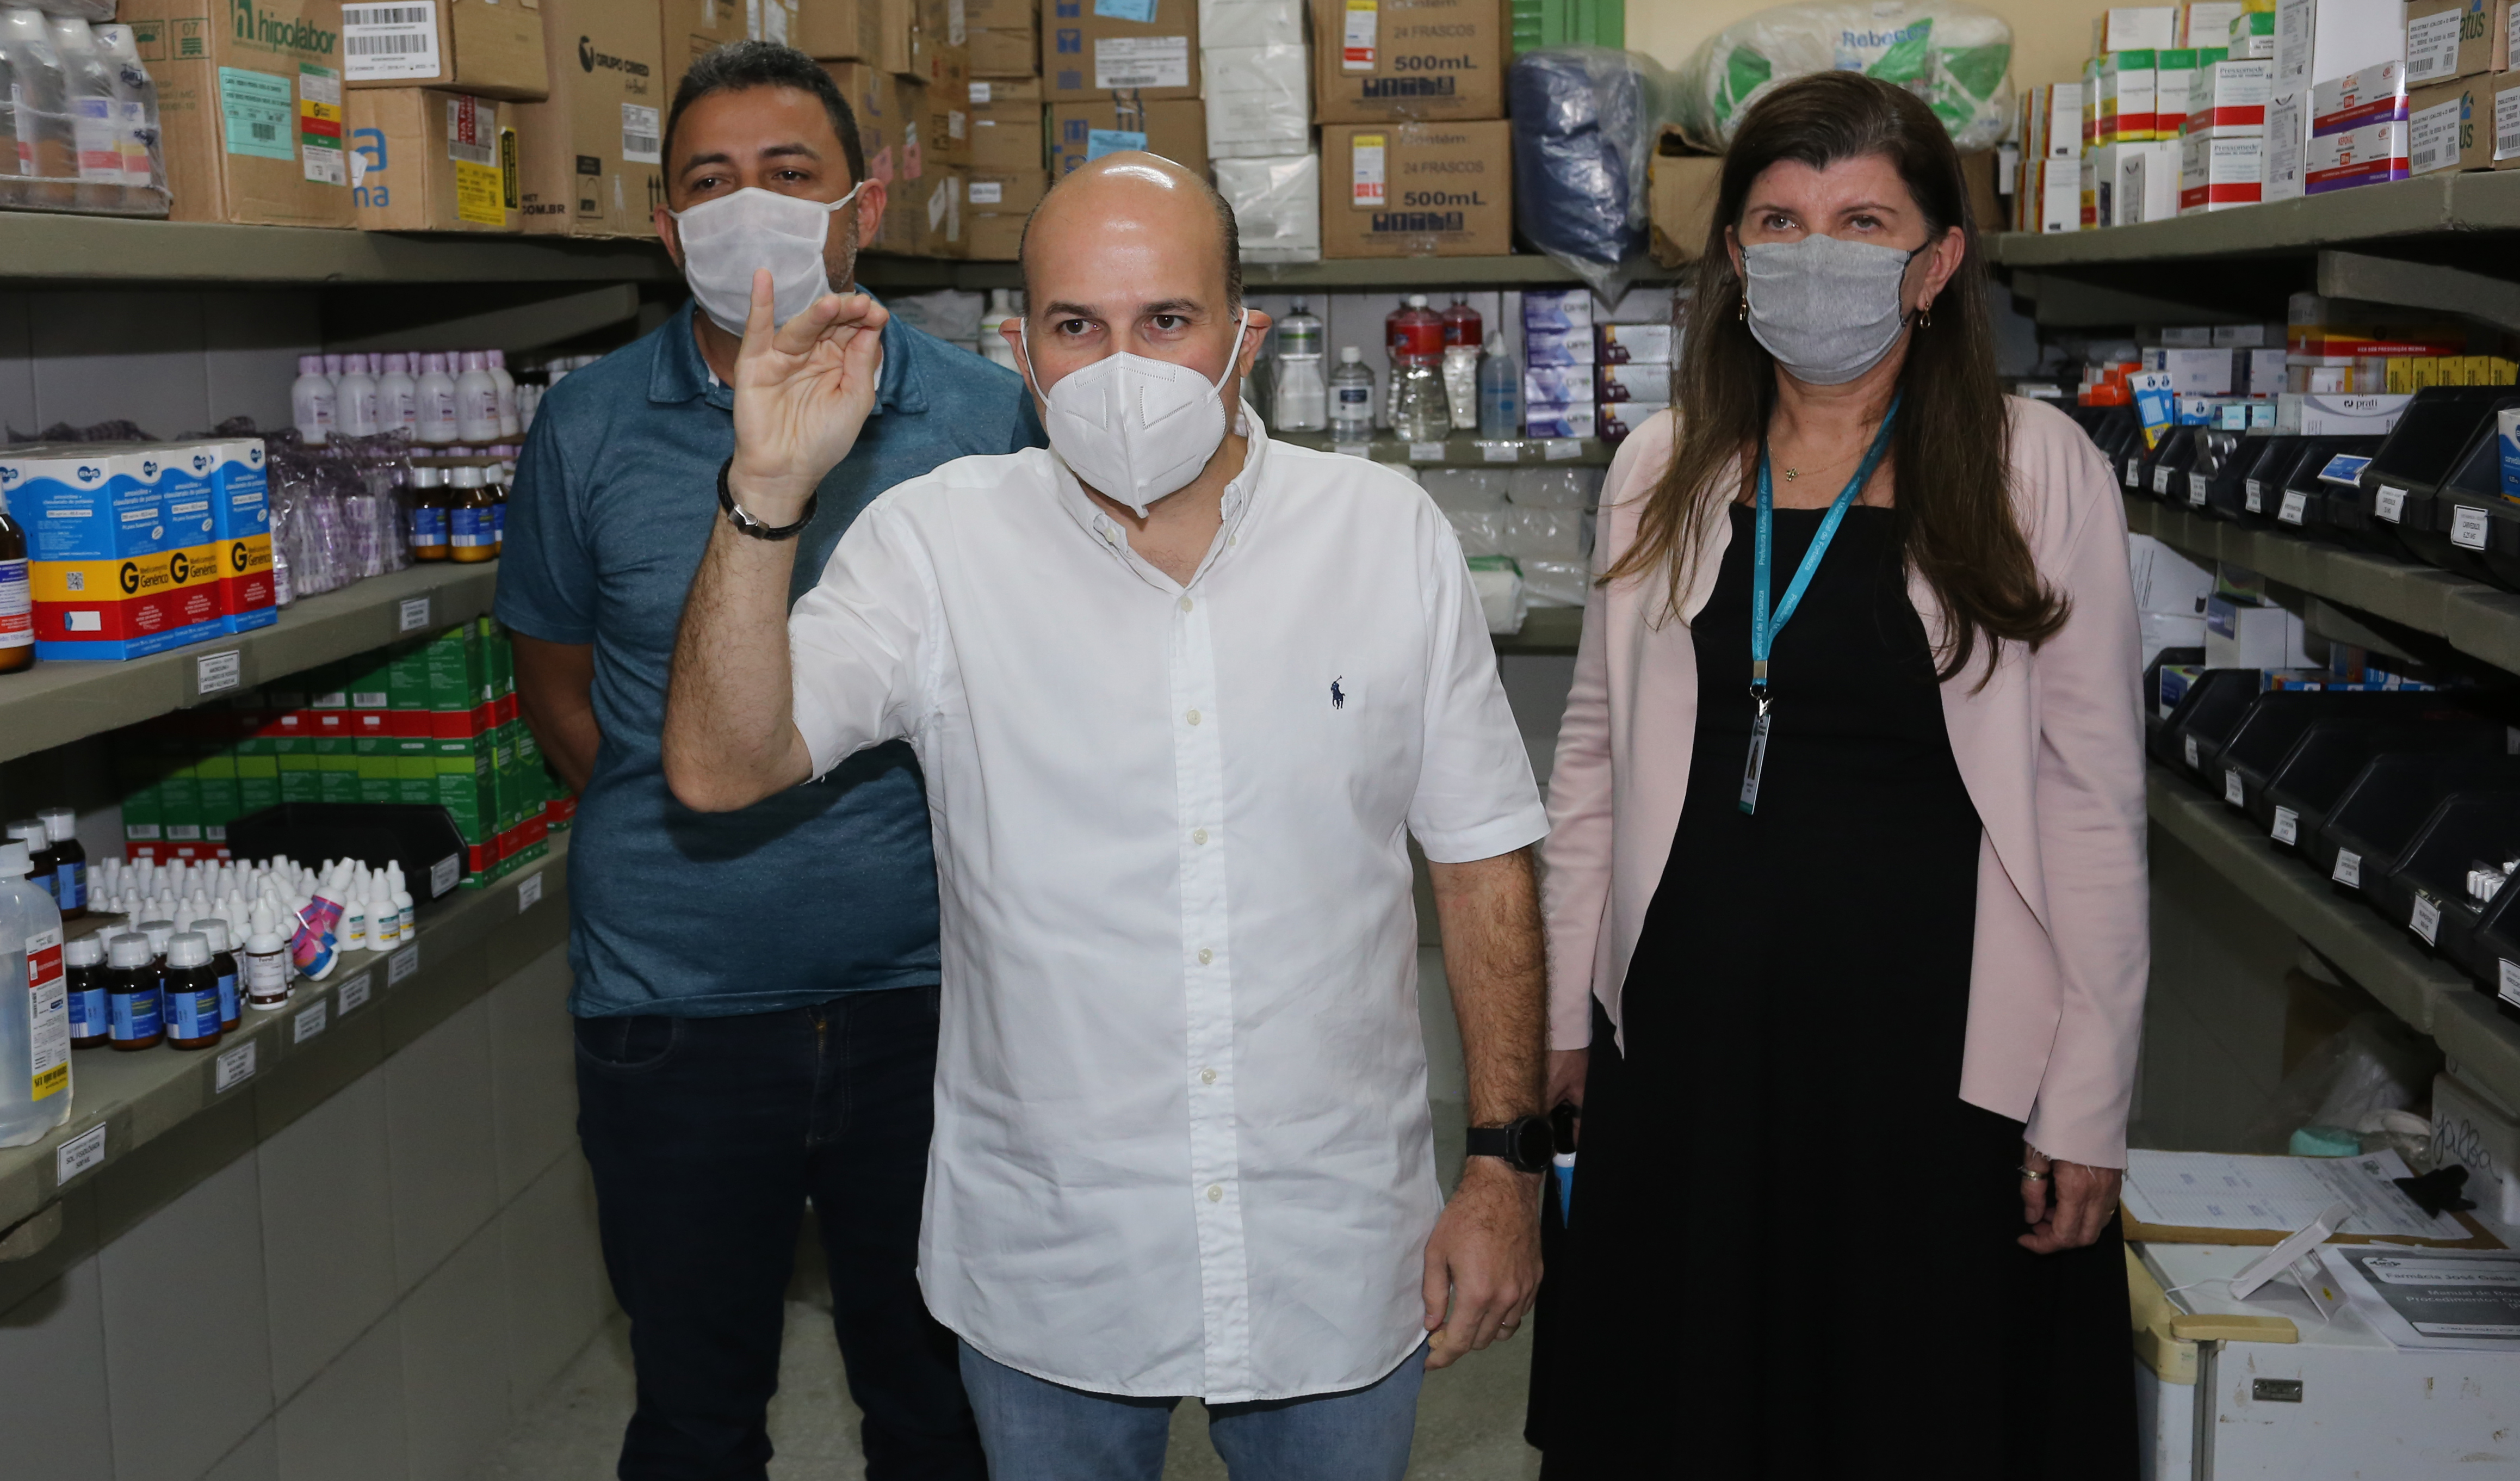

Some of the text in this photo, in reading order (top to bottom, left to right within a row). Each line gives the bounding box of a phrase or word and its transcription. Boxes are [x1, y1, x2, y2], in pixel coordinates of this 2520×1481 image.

[258, 9, 337, 54] hipolabor
[596, 53, 649, 77] GRUPO CIMED
[1395, 54, 1478, 72] 500mL
[1404, 190, 1488, 207] 500mL
[2356, 398, 2378, 410] prati
[1761, 495, 1767, 503] de
[1760, 505, 1768, 533] Municipal
[1820, 532, 1828, 540] de
[232, 542, 247, 572] G
[1758, 534, 1766, 565] Prefeitura
[1804, 540, 1824, 571] Fortaleza
[120, 561, 139, 594] G
[170, 552, 189, 584] G
[191, 564, 218, 578] Genérico
[140, 573, 169, 588] Genérico
[1756, 622, 1763, 631] de
